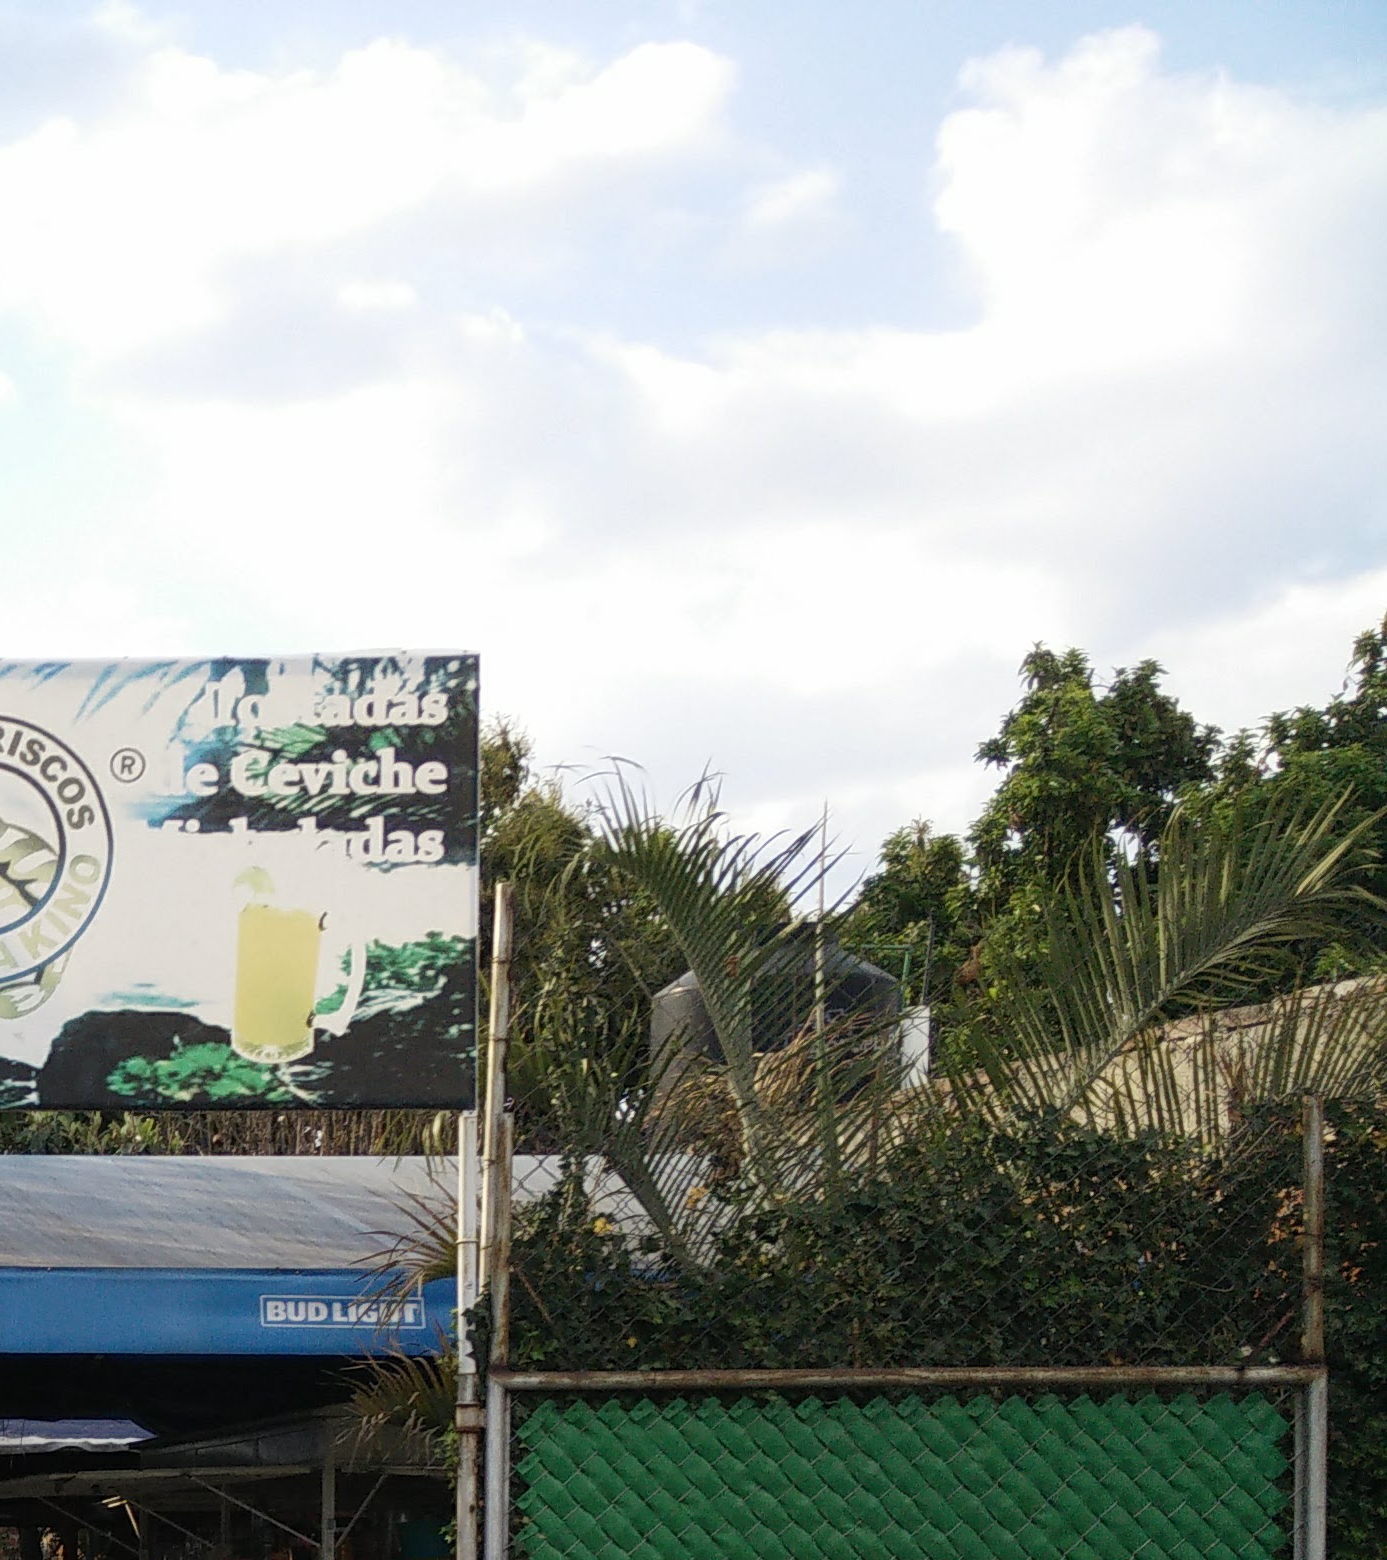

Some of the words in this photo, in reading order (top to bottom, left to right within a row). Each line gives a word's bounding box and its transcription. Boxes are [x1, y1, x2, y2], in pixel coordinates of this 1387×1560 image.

[230, 747, 449, 797] Ceviche
[31, 853, 103, 959] KINO
[266, 1300, 328, 1322] BUD
